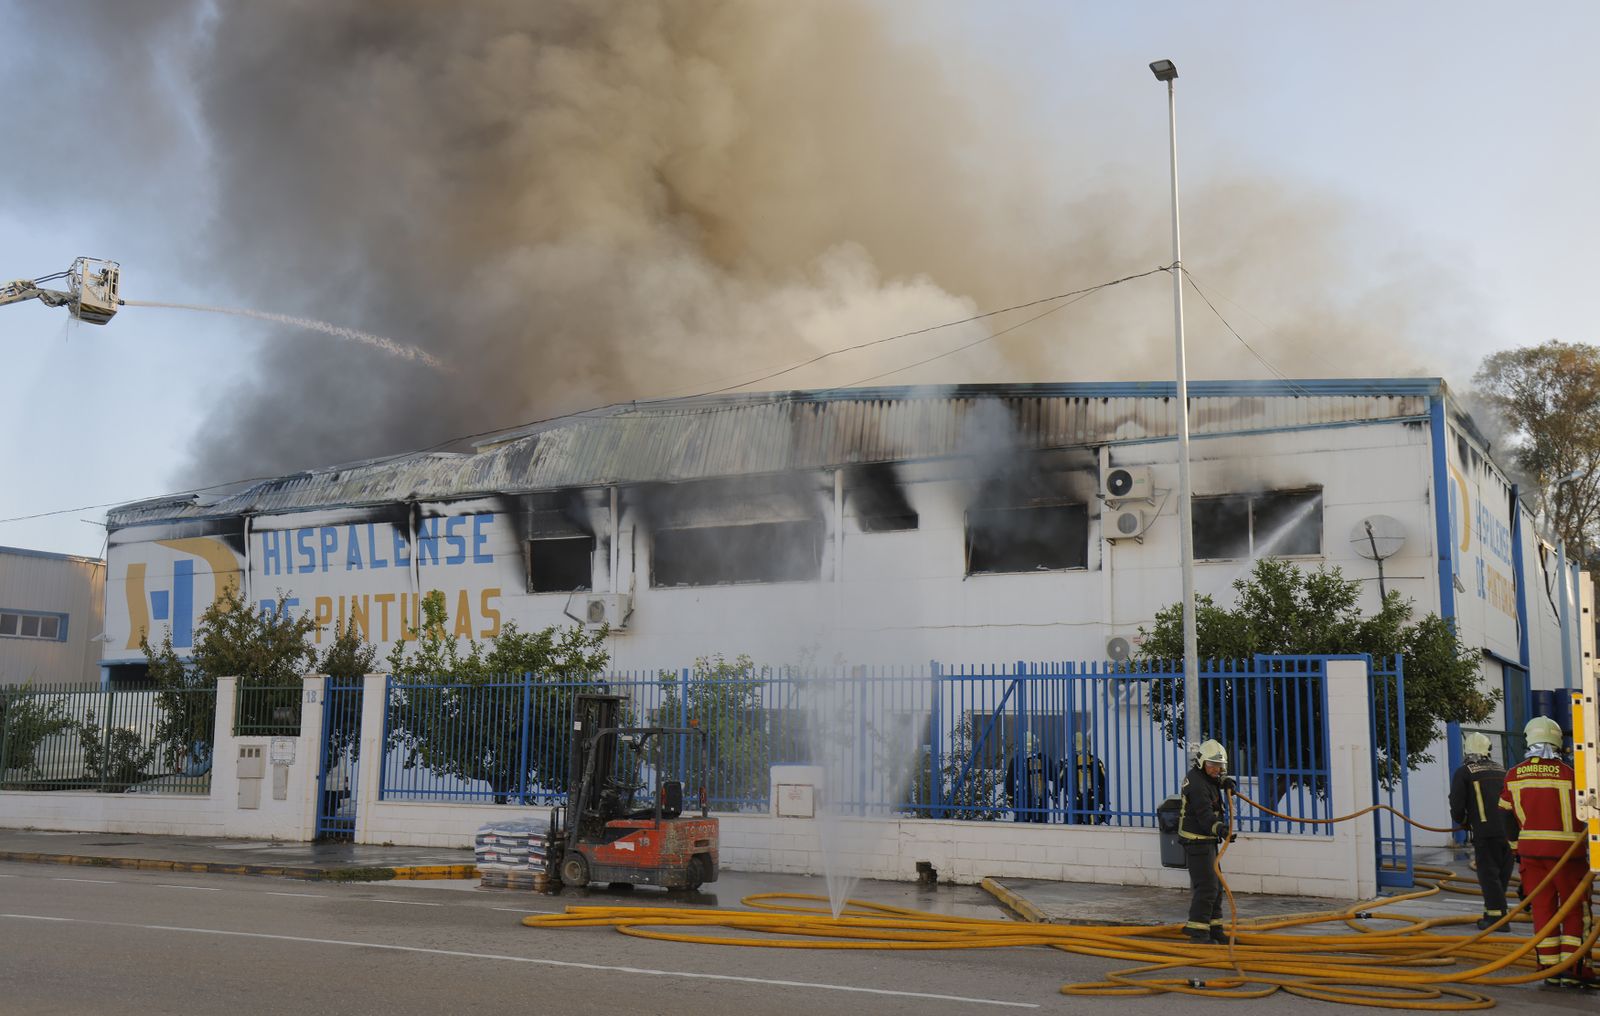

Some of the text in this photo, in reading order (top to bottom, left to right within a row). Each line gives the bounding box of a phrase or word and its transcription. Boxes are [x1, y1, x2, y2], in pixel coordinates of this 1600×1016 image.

[262, 513, 494, 576] HISPALENSE
[314, 588, 501, 644] PINTURAS
[305, 689, 317, 704] 18
[1516, 764, 1560, 775] BOMBEROS
